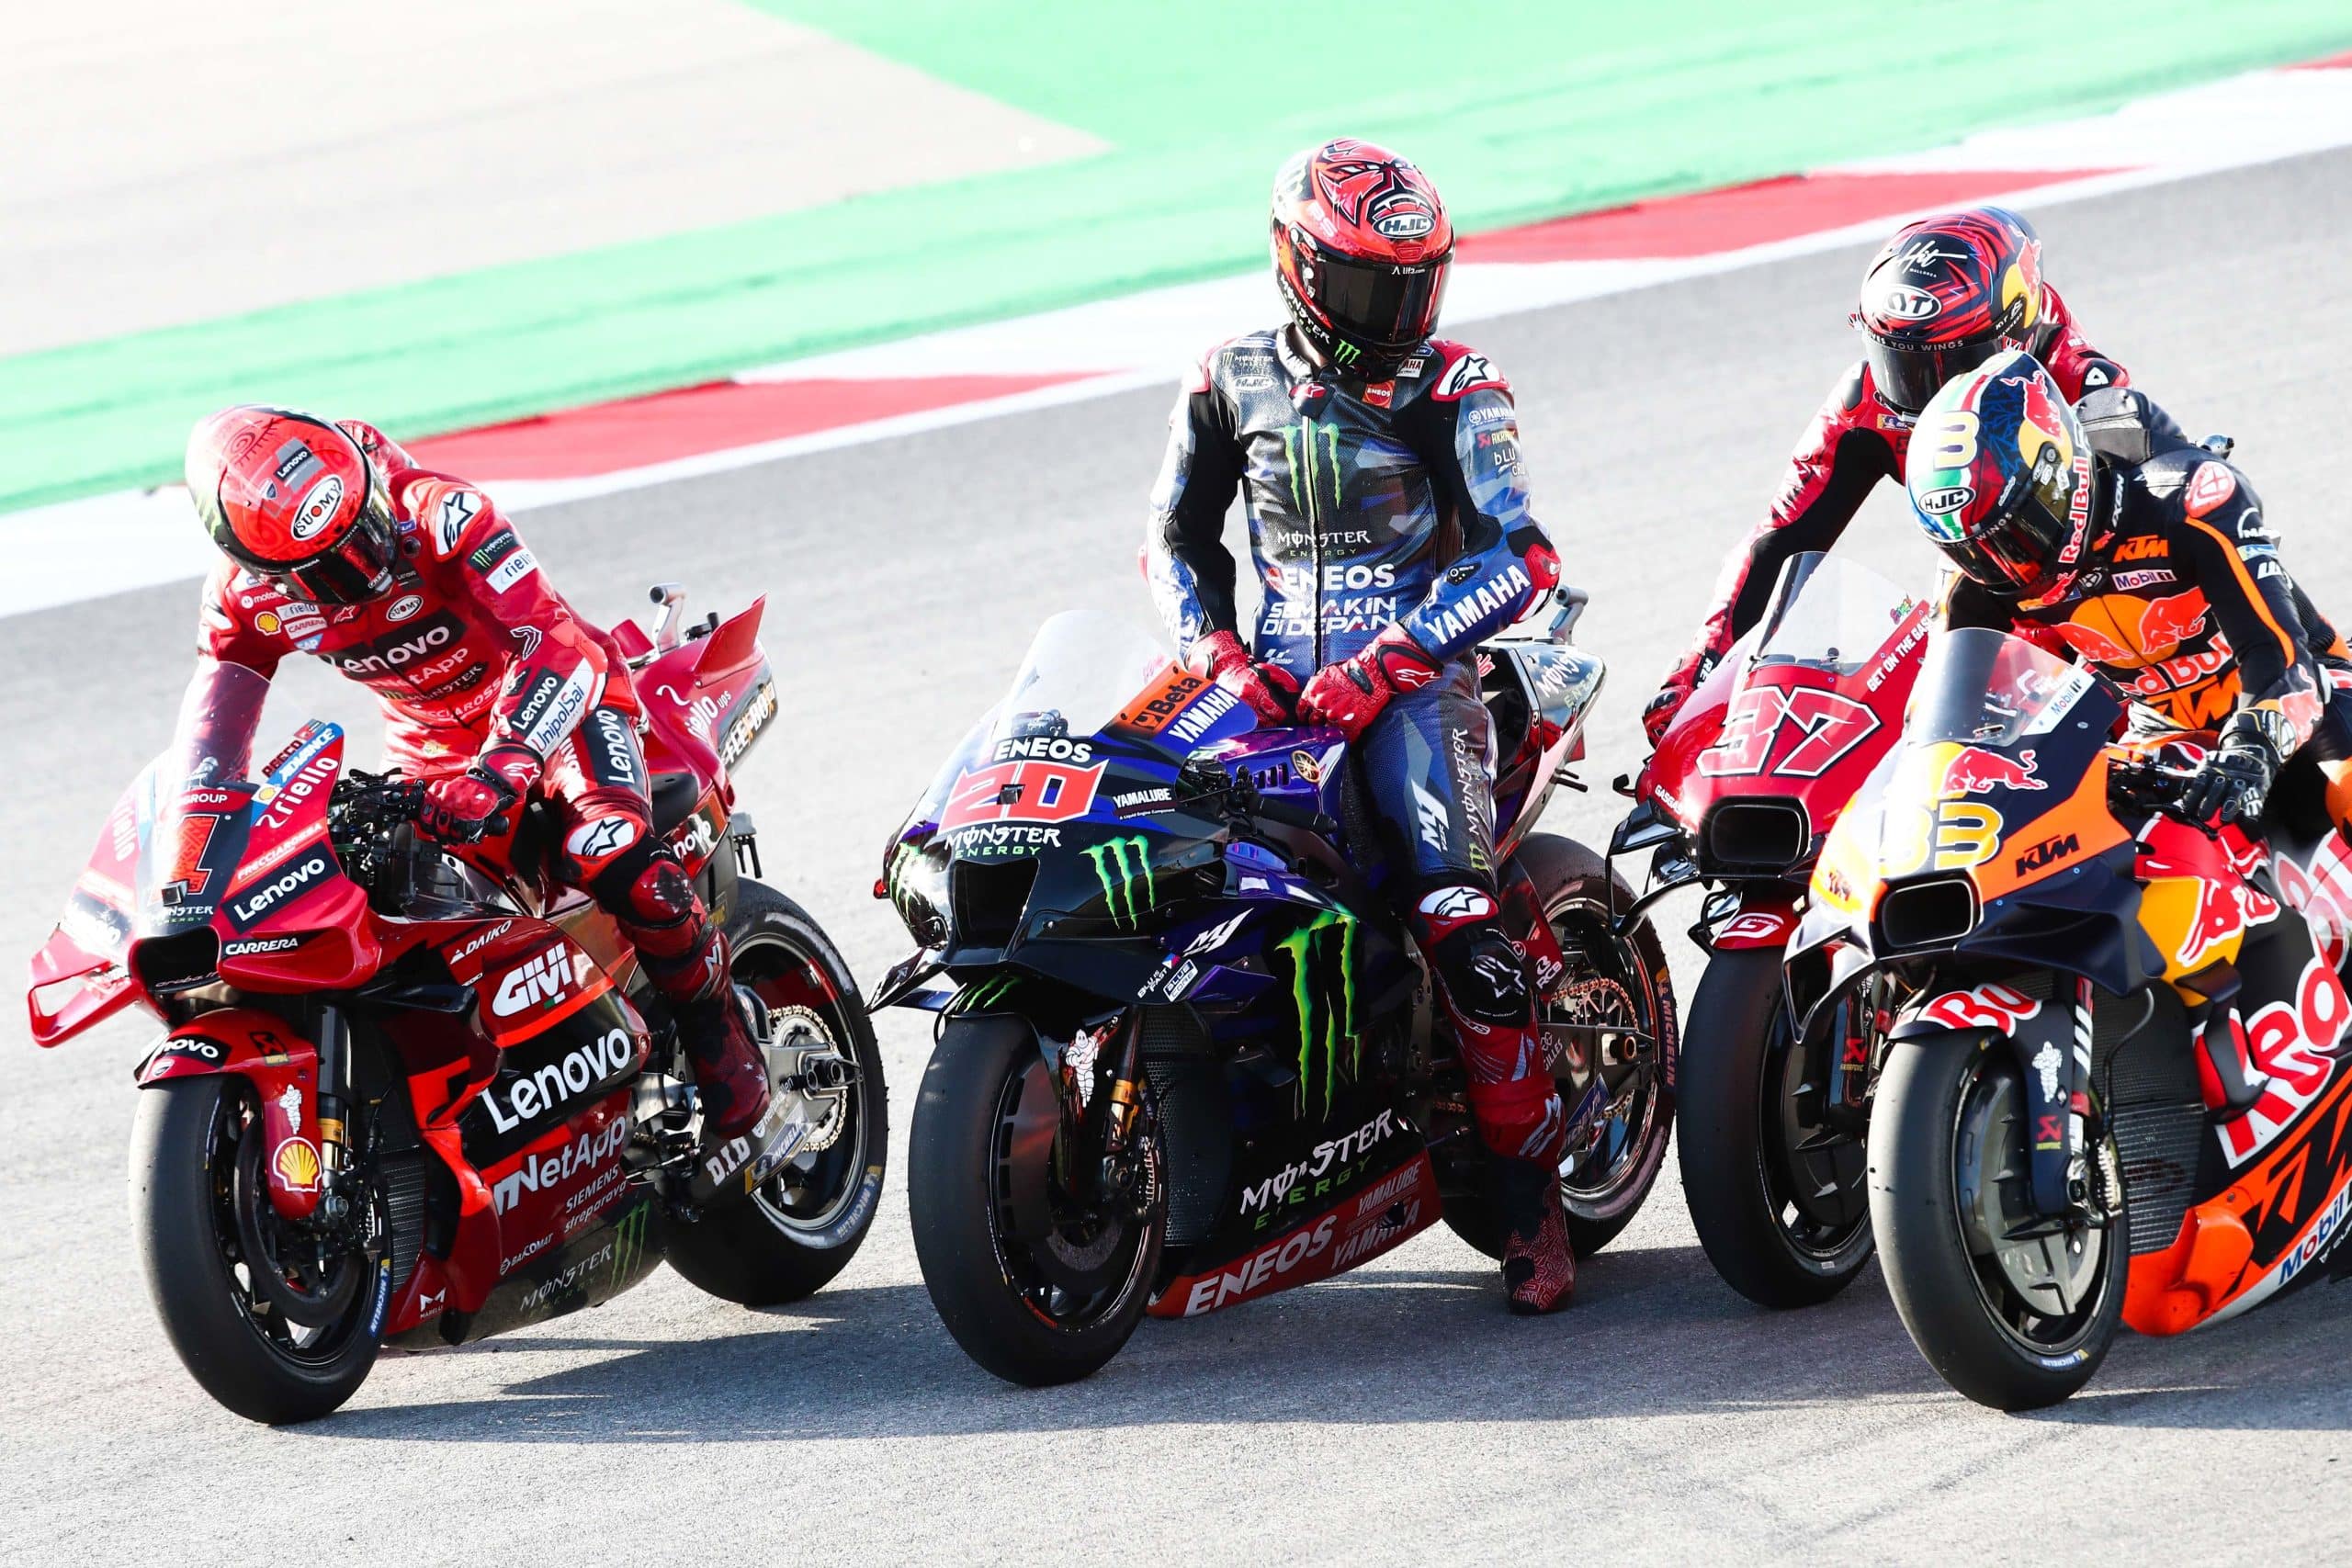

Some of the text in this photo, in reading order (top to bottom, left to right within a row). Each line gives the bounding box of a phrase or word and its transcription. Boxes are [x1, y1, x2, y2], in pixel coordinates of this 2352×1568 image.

[1383, 219, 1428, 234] HJC
[1280, 275, 1330, 344] MONSTER
[1891, 342, 1915, 351] YOU
[1920, 340, 1964, 352] WINGS
[1367, 387, 1391, 397] ENEOS
[277, 449, 308, 479] Lenovo
[296, 481, 343, 533] SUOMY
[1925, 490, 1964, 510] HJC
[2057, 457, 2090, 564] Red Bull
[1277, 529, 1372, 545] MONSTER
[1289, 548, 1359, 558] ENERGY
[2113, 535, 2168, 563] KTM
[1284, 563, 1396, 594] ENEOS
[2115, 571, 2156, 592] Mobil
[390, 598, 421, 619] SUOMY
[1424, 563, 1531, 645] YAMAHA
[345, 626, 450, 674] enovo
[408, 647, 469, 685] tApp
[1867, 667, 1886, 693] GET
[1883, 652, 1899, 673] ON
[1895, 634, 1917, 658] THE
[513, 676, 559, 730] Lenovo
[535, 681, 586, 753] UnipolSai
[718, 690, 732, 708] ups
[1146, 677, 1204, 716] Beta
[1168, 686, 1239, 744] YAMAHA
[2051, 686, 2075, 715] Mobil
[595, 709, 636, 784] Lenovo
[993, 738, 1092, 762] ENEOS
[1696, 684, 1883, 780] 37
[275, 757, 339, 816] riello
[937, 759, 1110, 834] 20
[1113, 788, 1172, 808] YAMALUBE
[1453, 728, 1480, 836] MONSTER
[149, 814, 220, 907] 1
[673, 818, 712, 860] novo
[944, 824, 1061, 851] MONSTER
[955, 845, 1042, 859] ENERGY
[2016, 833, 2081, 878] KTM
[233, 858, 325, 923] Lenovo
[225, 937, 299, 955] CARRERA
[465, 919, 513, 956] DAIKO
[492, 942, 573, 1017] GIVI
[1166, 964, 1192, 992] BLUE
[1536, 964, 1563, 990] RCB
[1662, 998, 1675, 1087] MICHELIN
[481, 1027, 631, 1134] Lenovo
[519, 1114, 627, 1192] NetApp
[706, 1137, 751, 1187] D.I.D
[565, 1163, 618, 1214] SIEMENS
[836, 1188, 871, 1238] MICHELIN
[1254, 1155, 1373, 1231] EERGY
[1357, 1161, 1422, 1217] YAMALUBE
[1331, 1199, 1421, 1269] YAMAA
[2278, 1190, 2345, 1286] Mobil
[520, 1243, 612, 1312] MONSTER
[1183, 1214, 1338, 1317] ENEOS
[369, 1279, 388, 1336] MICHELIN
[420, 1304, 444, 1319] MARELLI
